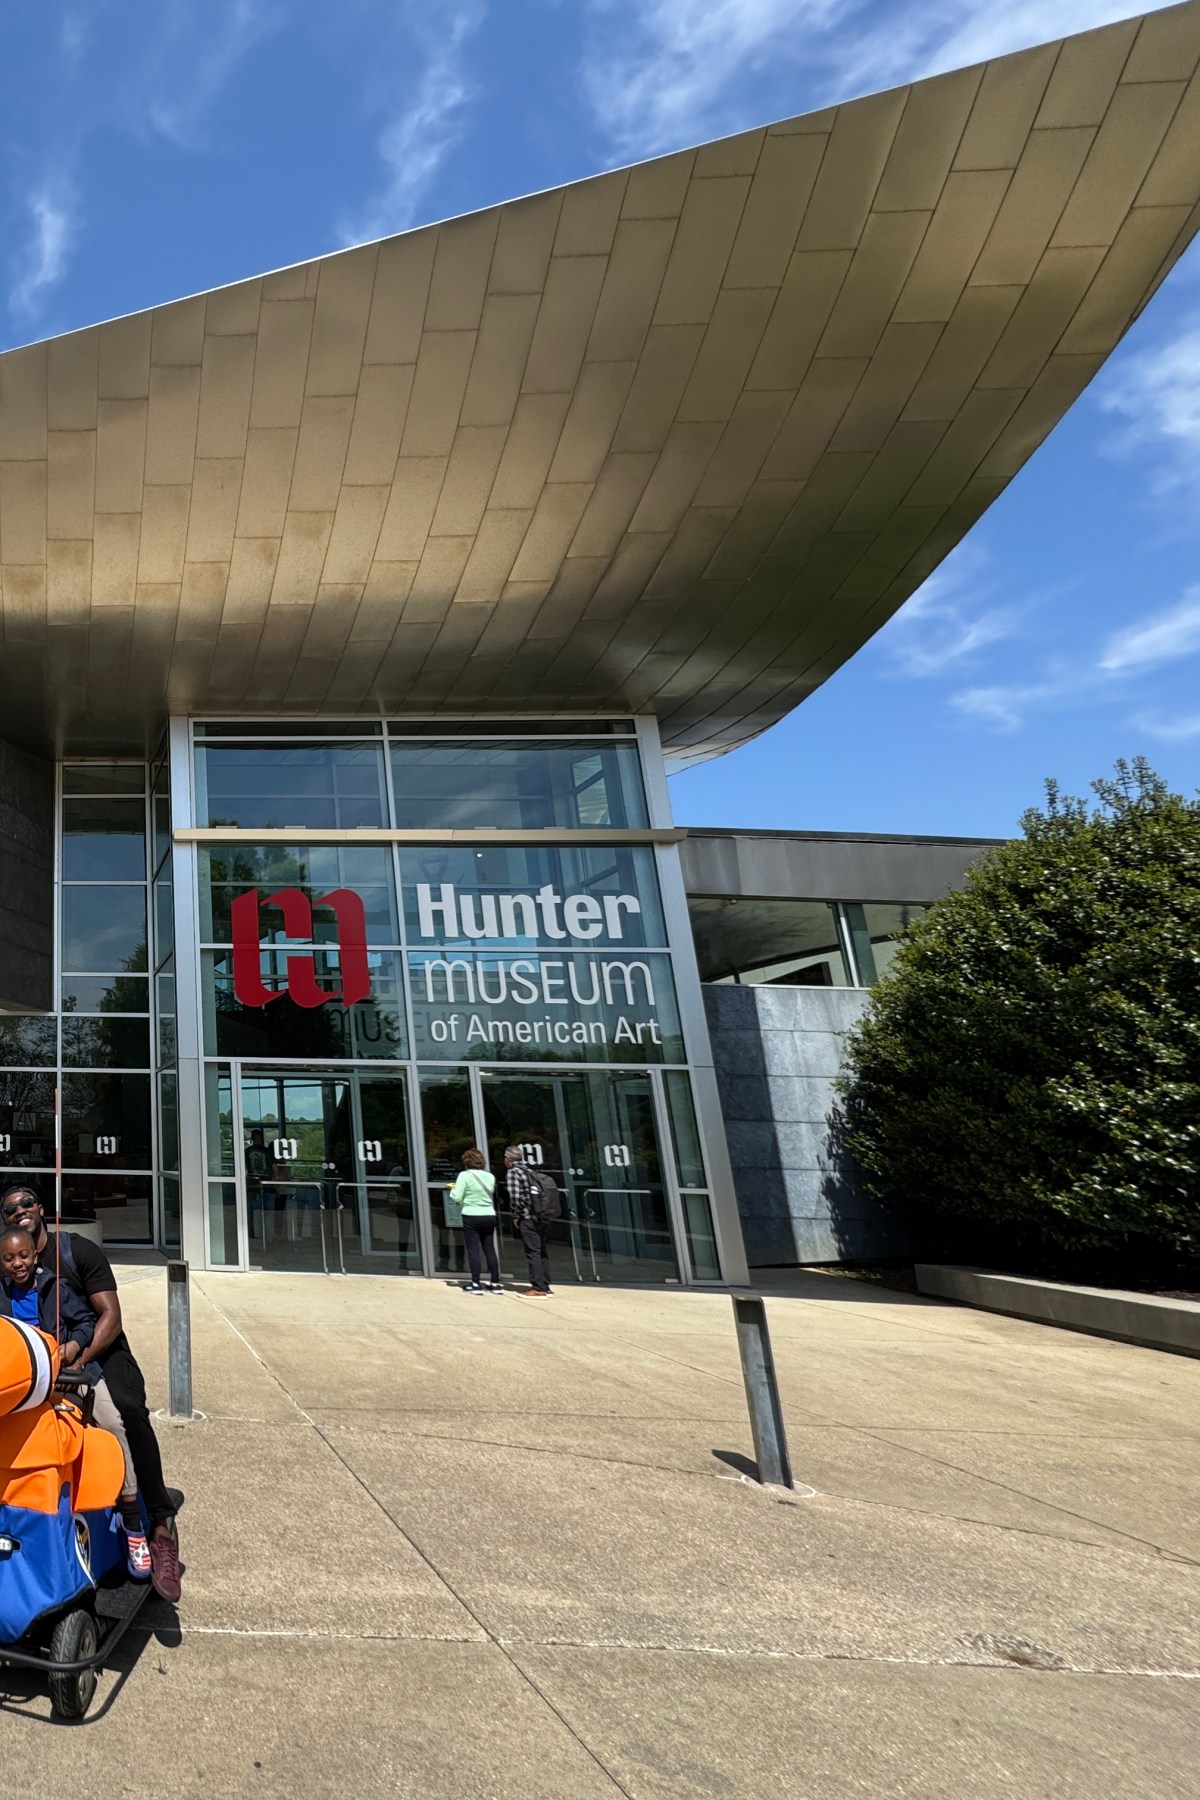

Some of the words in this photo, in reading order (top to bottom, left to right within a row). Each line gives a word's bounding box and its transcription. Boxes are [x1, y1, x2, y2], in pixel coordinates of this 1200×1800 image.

[416, 883, 641, 940] Hunter
[431, 1014, 459, 1042] of
[467, 1014, 608, 1044] American
[614, 1016, 662, 1045] Art
